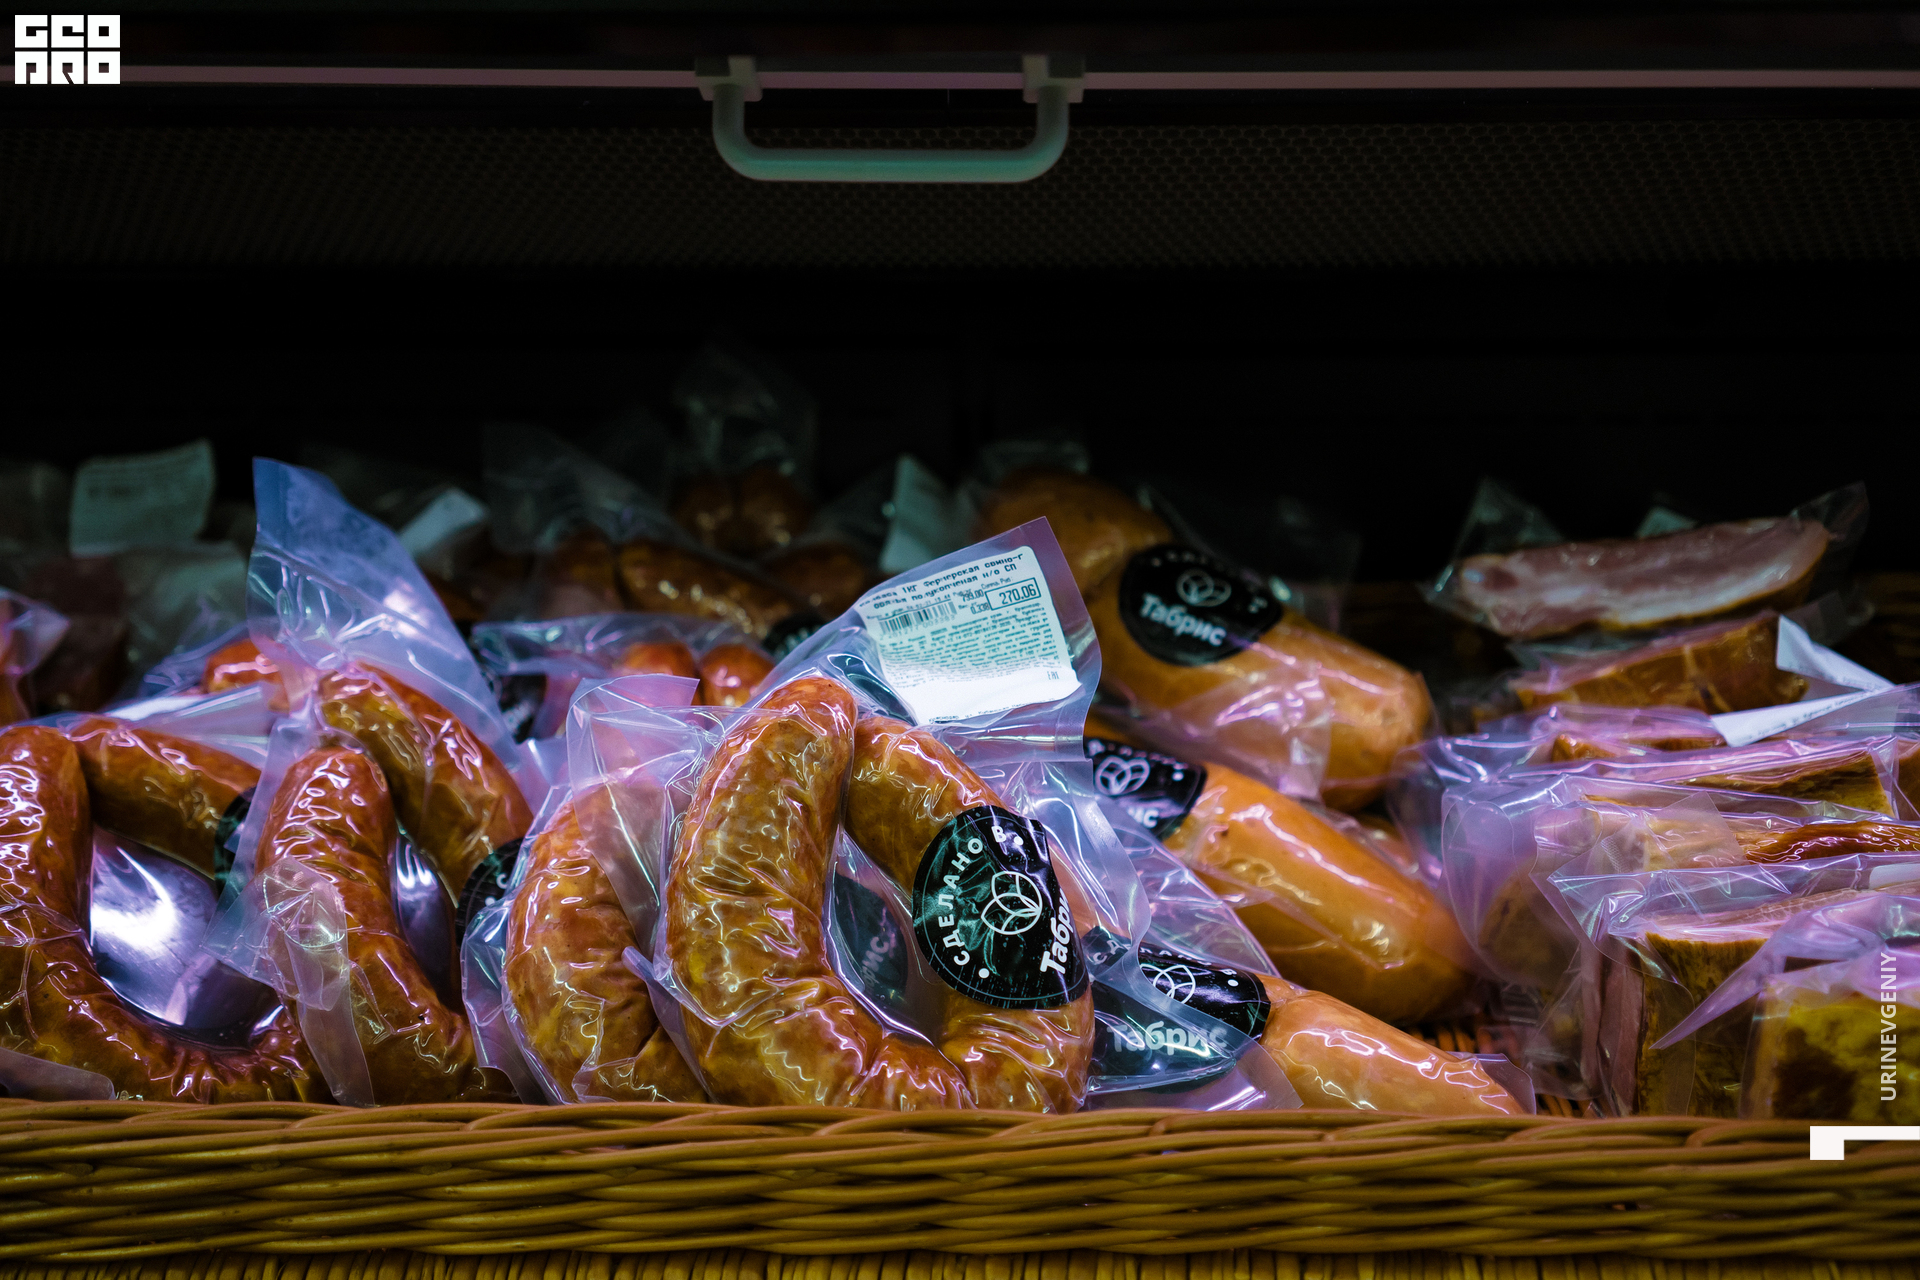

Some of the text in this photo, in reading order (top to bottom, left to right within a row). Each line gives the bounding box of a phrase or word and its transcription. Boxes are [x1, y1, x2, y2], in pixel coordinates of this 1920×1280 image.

[1004, 563, 1017, 573] СП
[999, 583, 1037, 605] 270.06
[1140, 592, 1227, 647] Табрис
[938, 825, 1006, 966] СДЕЛАНО В
[1106, 1020, 1228, 1056] Табрис
